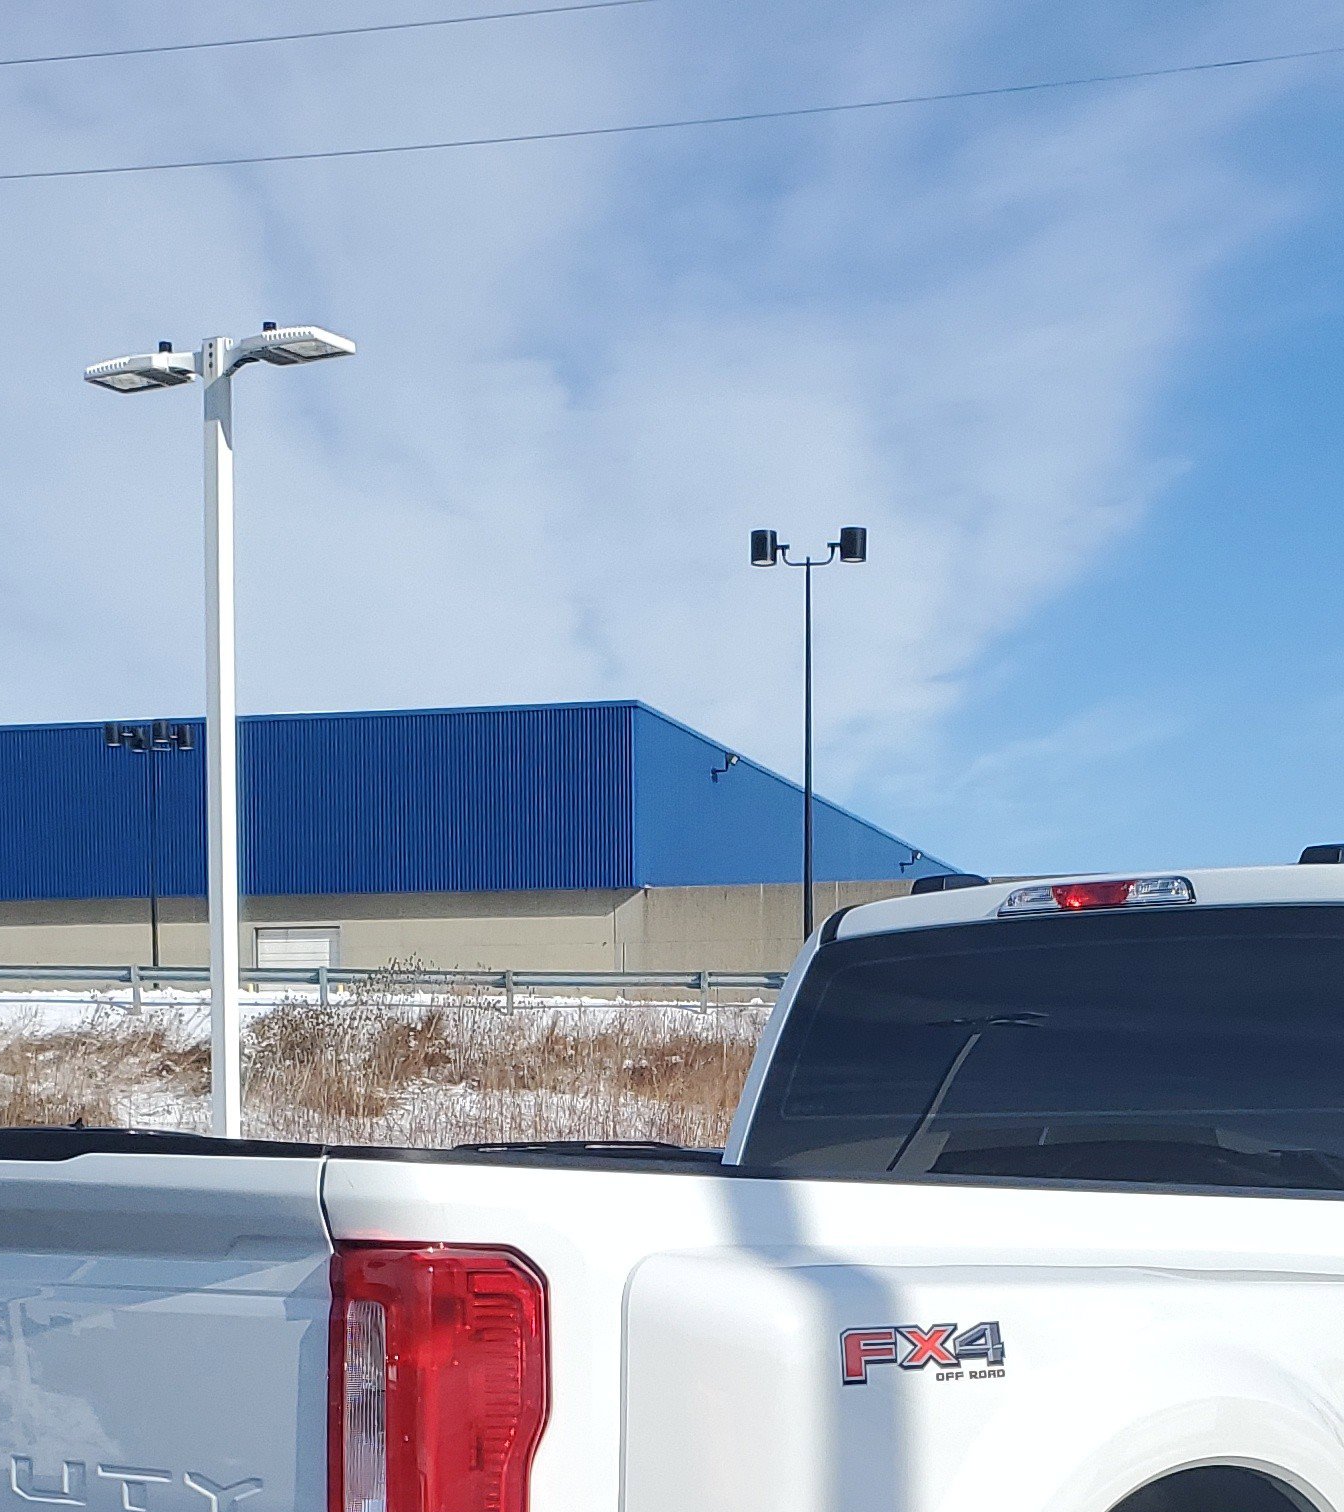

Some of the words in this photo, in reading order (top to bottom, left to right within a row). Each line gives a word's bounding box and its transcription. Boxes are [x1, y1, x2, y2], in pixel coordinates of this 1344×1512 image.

[839, 1321, 1006, 1386] FX4
[935, 1371, 964, 1382] OFF
[969, 1368, 1006, 1380] ROAD
